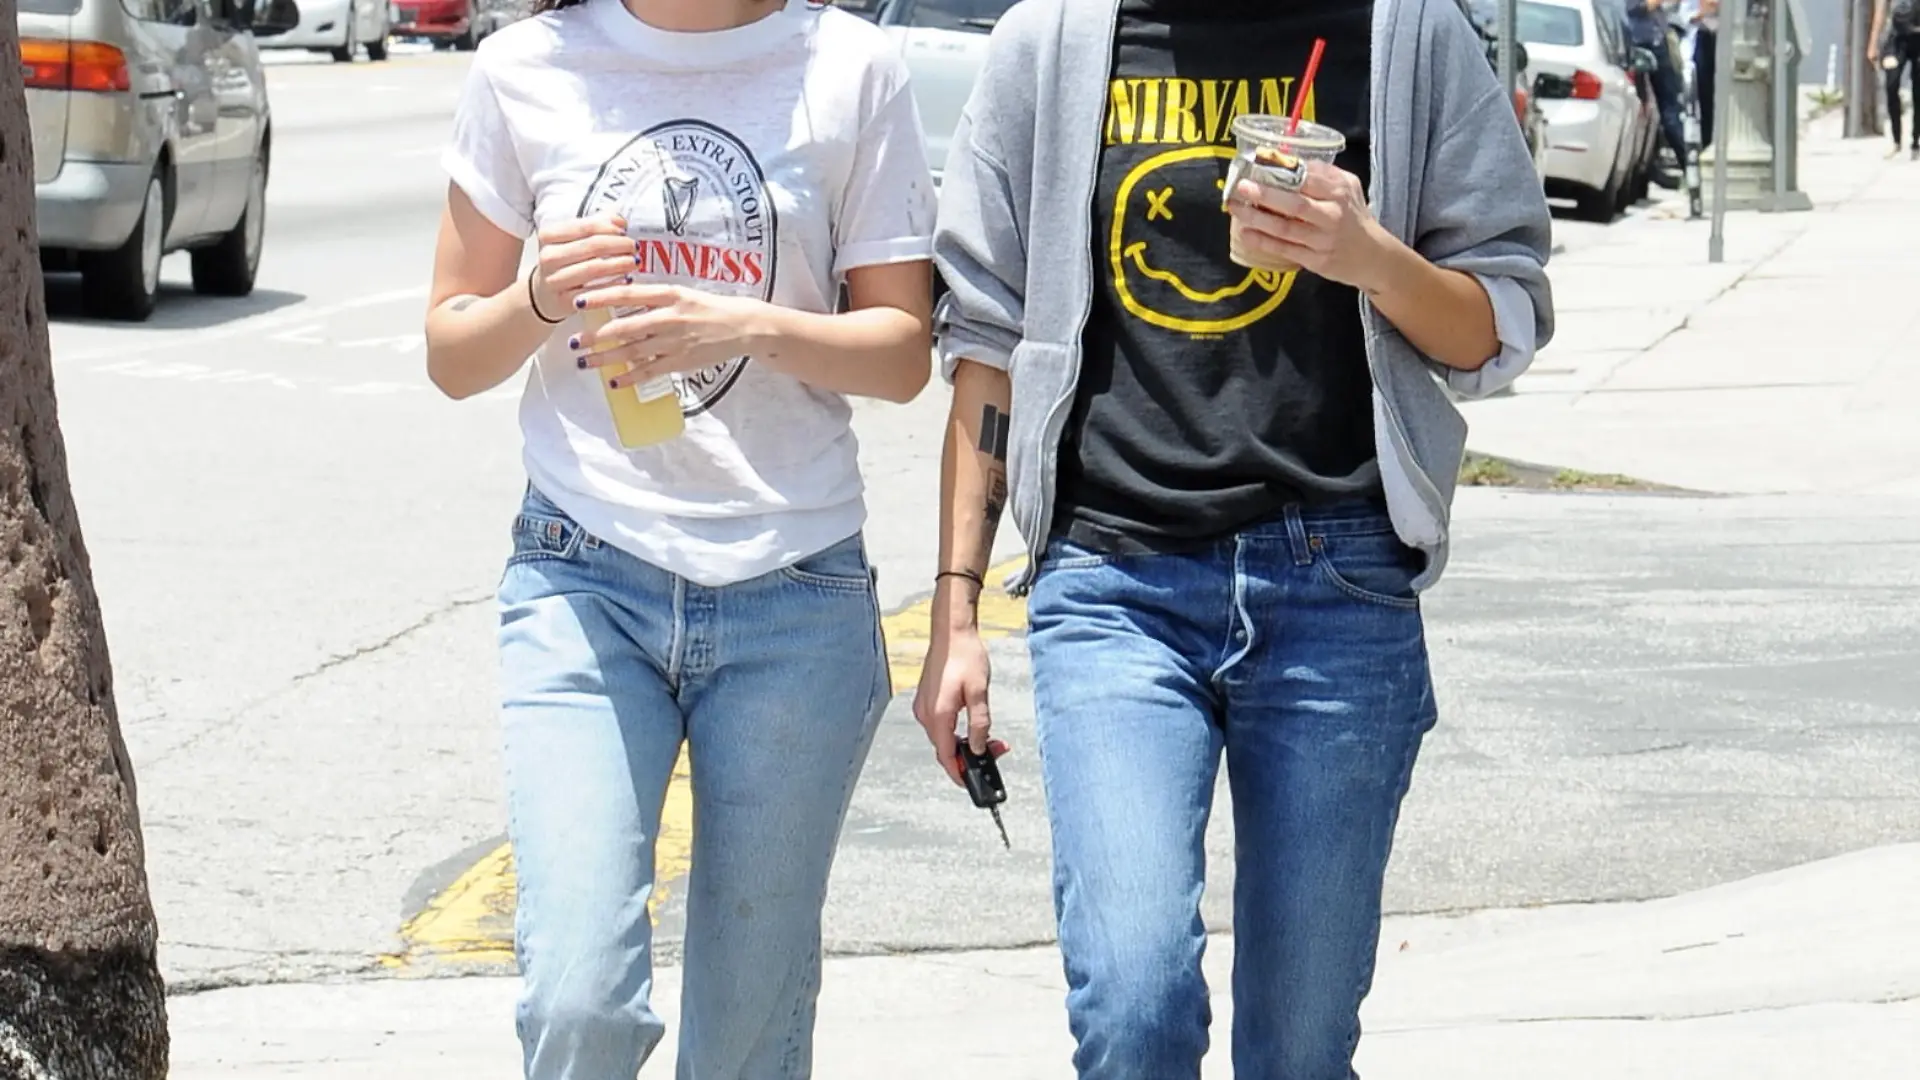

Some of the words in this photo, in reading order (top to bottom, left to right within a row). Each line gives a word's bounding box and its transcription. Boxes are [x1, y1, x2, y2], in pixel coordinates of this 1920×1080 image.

[673, 134, 736, 174] EXTRA
[731, 171, 764, 247] STOUT
[638, 239, 763, 285] INNESS
